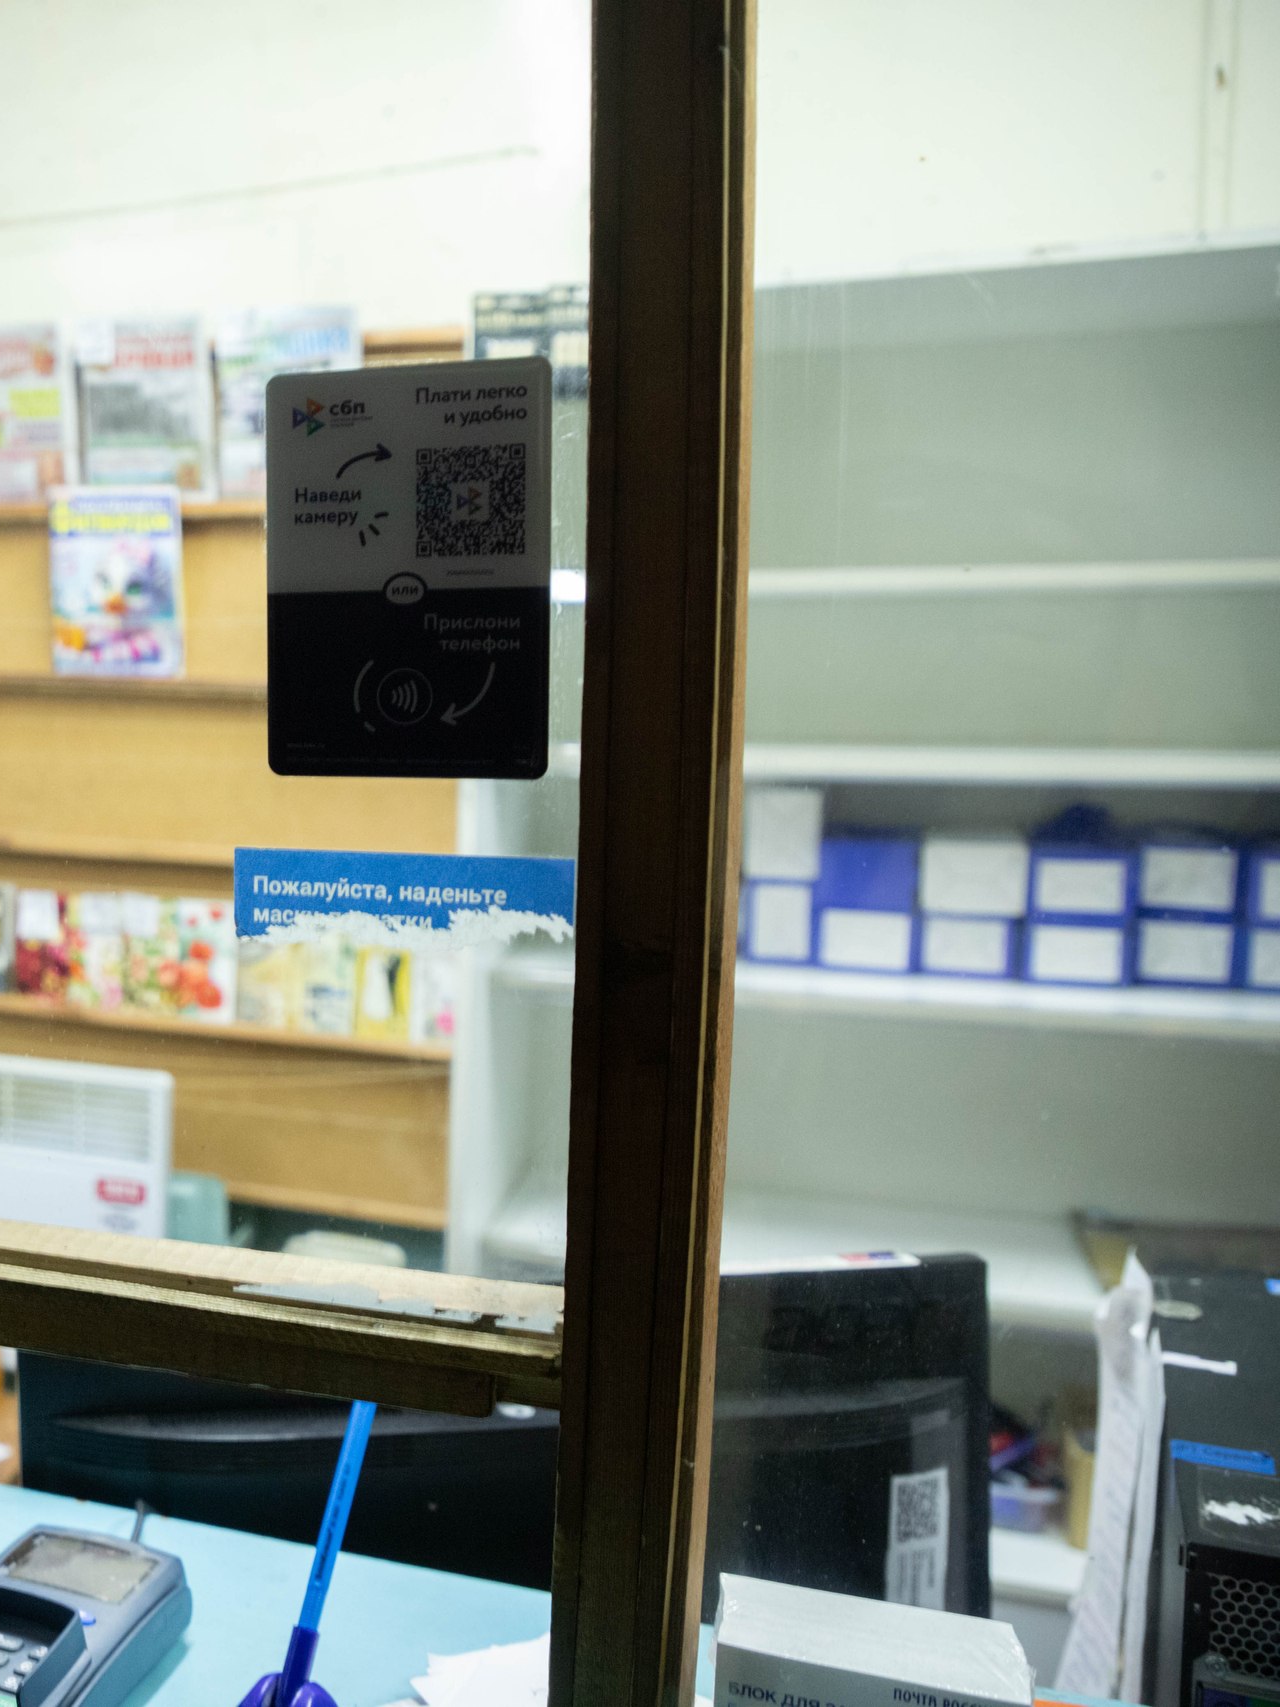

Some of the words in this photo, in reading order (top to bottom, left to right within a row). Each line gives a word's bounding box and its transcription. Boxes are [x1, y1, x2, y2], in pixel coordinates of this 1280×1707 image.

[416, 387, 471, 404] Плати
[476, 384, 528, 401] легко
[444, 411, 455, 424] и
[461, 404, 528, 428] удобно
[294, 487, 362, 505] Наведи
[294, 509, 359, 527] камеру
[391, 584, 420, 597] или
[423, 613, 521, 634] Прислони
[439, 634, 521, 654] телефон
[253, 875, 393, 903] Пожалуйста,
[399, 884, 508, 906] наденьте
[728, 1681, 777, 1704] БЛОК
[893, 1687, 938, 1707] ПОЧТА
